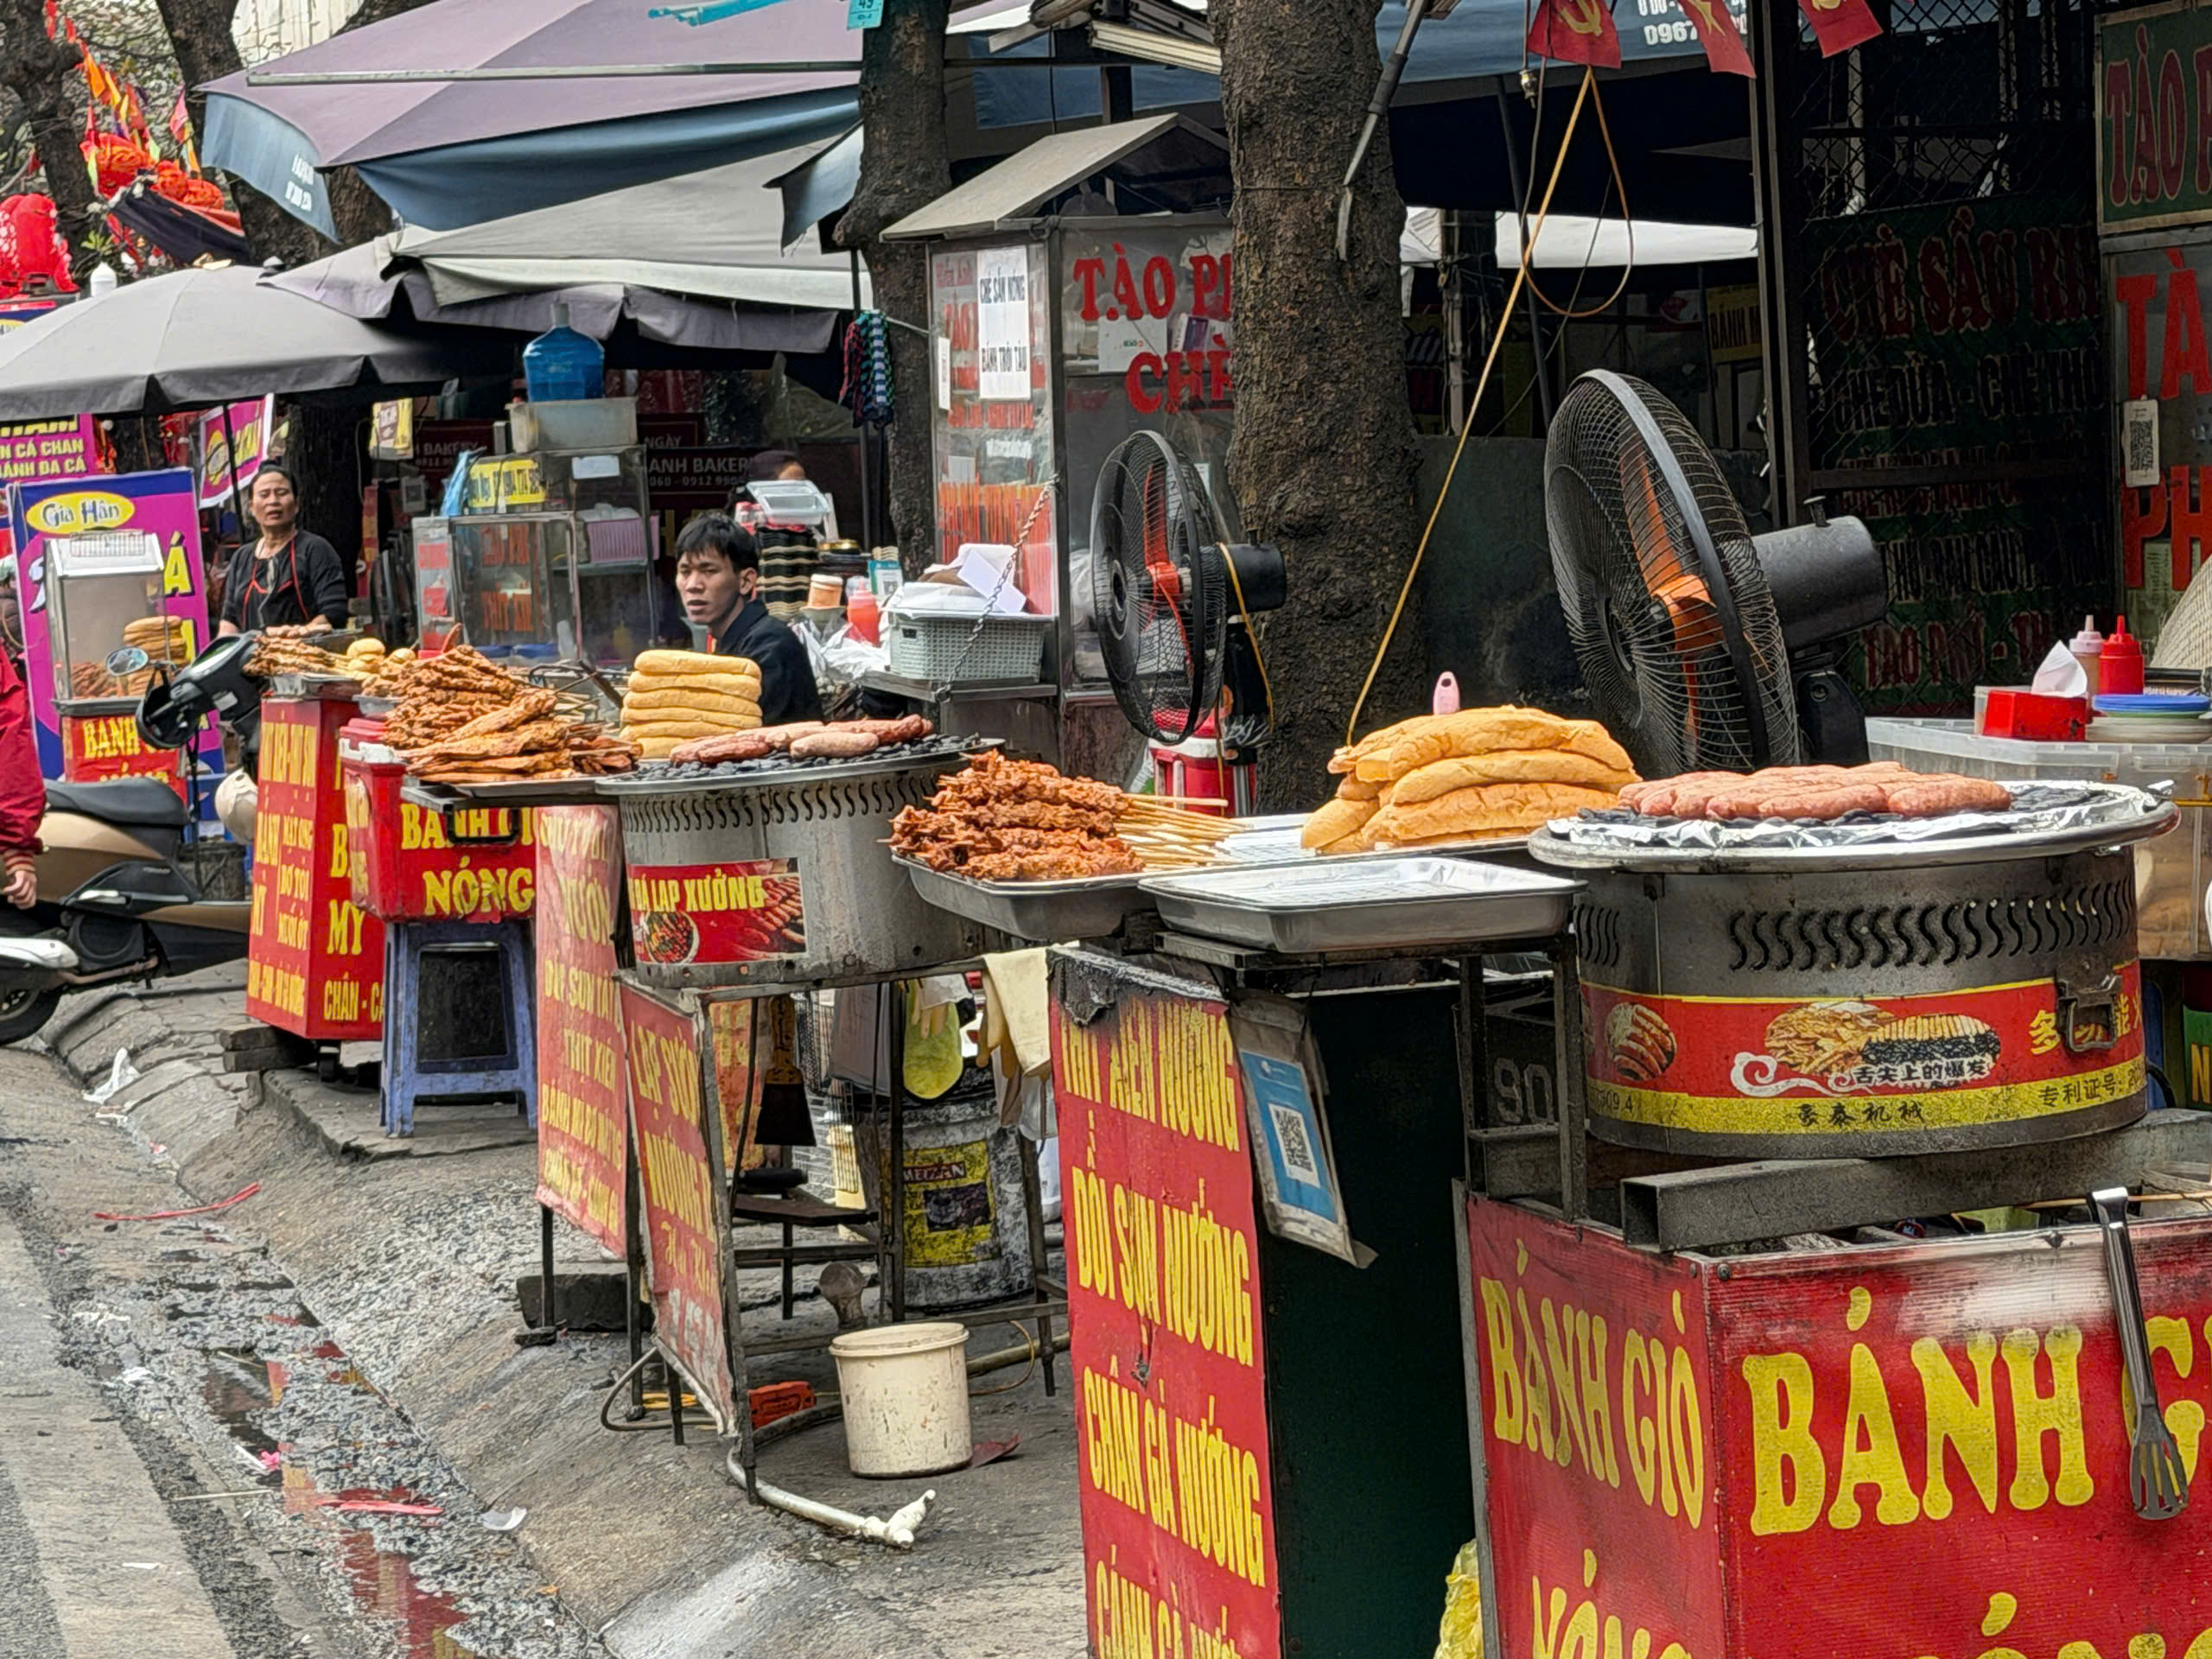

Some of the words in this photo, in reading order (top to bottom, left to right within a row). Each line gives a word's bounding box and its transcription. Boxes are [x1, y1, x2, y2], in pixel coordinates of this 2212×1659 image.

[1073, 242, 1175, 321] TÀO
[0, 461, 35, 479] ÁNH
[64, 454, 86, 474] CÁ
[15, 437, 37, 459] CÁ
[692, 456, 751, 474] BAKER
[41, 502, 74, 526] Gia
[79, 499, 119, 524] Hân
[423, 855, 535, 916] NÓNG
[683, 868, 767, 912] XƯỞNG
[1162, 1178, 1253, 1367] NƯỚNG
[1480, 1237, 1620, 1490] BÁNH
[1622, 1289, 1705, 1529] GIÒ
[1742, 1287, 2094, 1536] BÁNH
[1174, 1395, 1265, 1588] NƯỚNG
